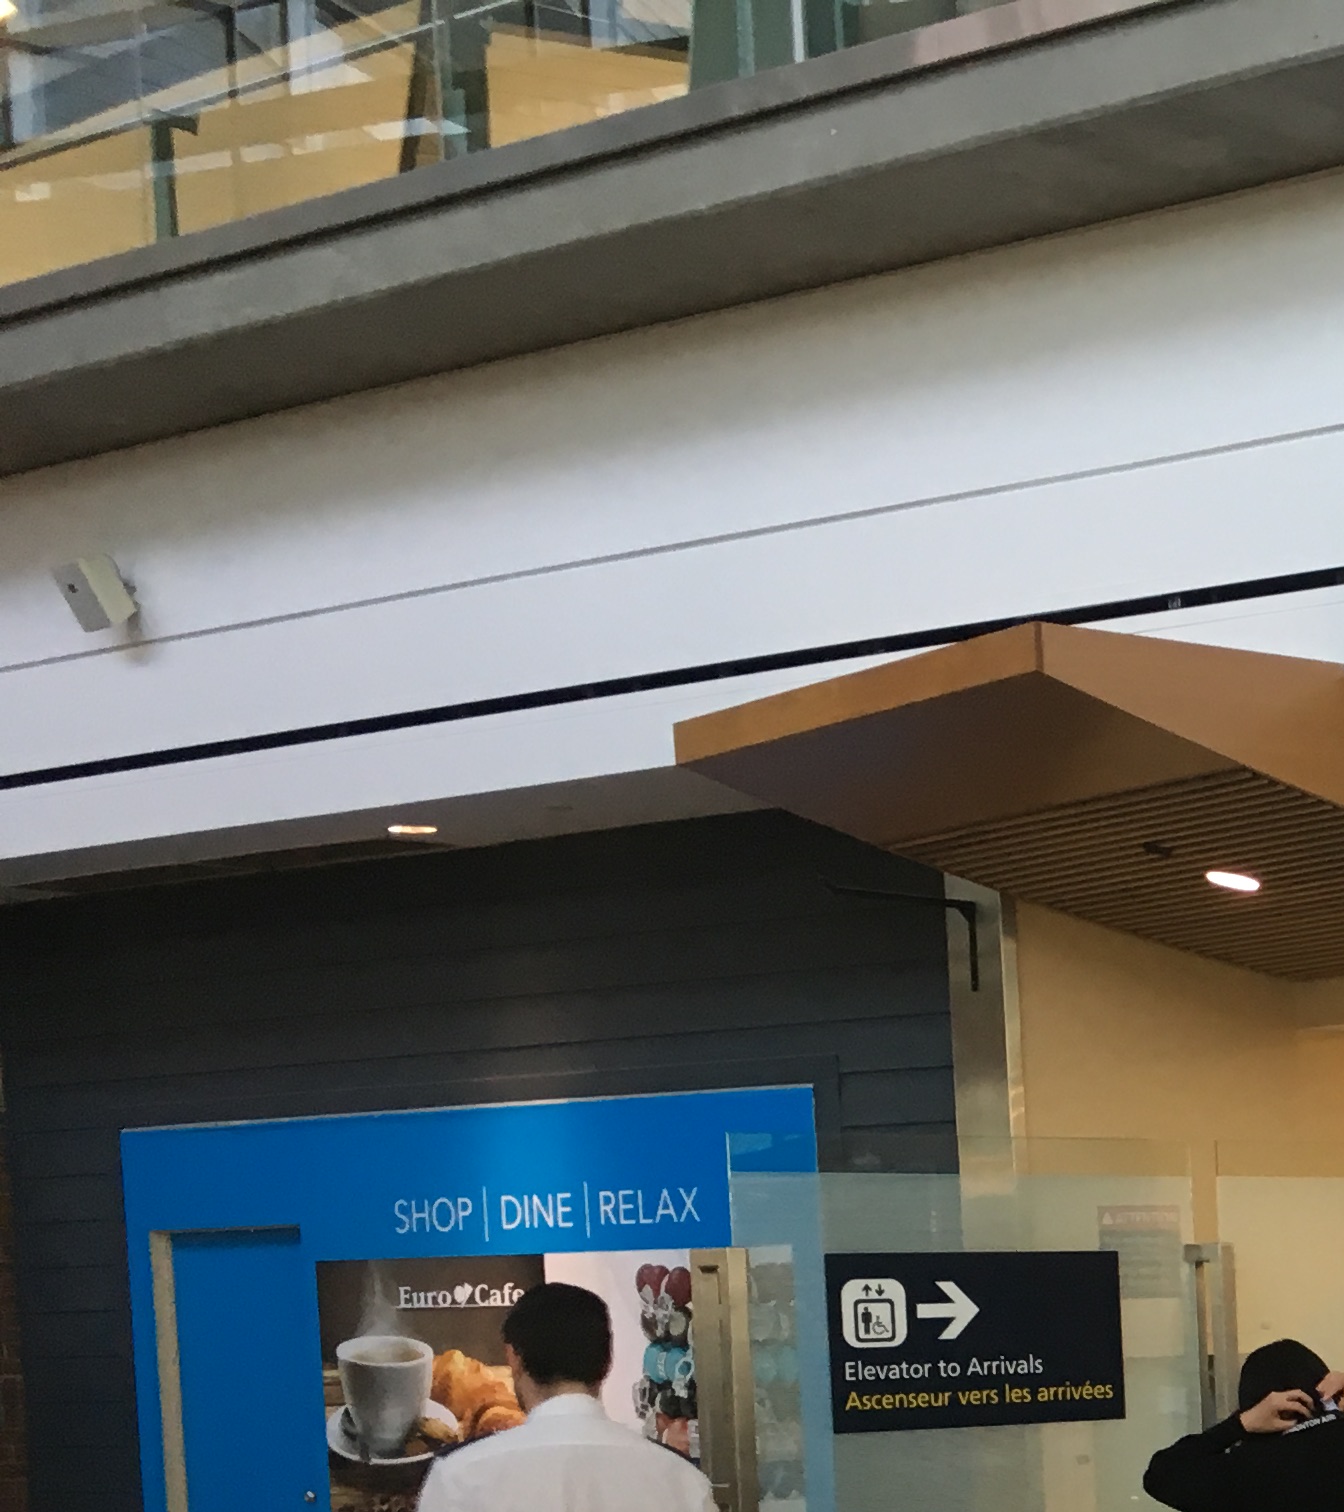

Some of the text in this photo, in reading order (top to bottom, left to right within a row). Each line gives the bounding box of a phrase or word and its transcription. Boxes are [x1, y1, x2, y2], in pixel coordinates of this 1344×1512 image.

[394, 1186, 701, 1234] SHOP DINE RELAX
[398, 1285, 452, 1308] Euro
[844, 1353, 1044, 1382] Elevator to Arrivals
[845, 1380, 1114, 1411] Ascenseur vers les arrivées
